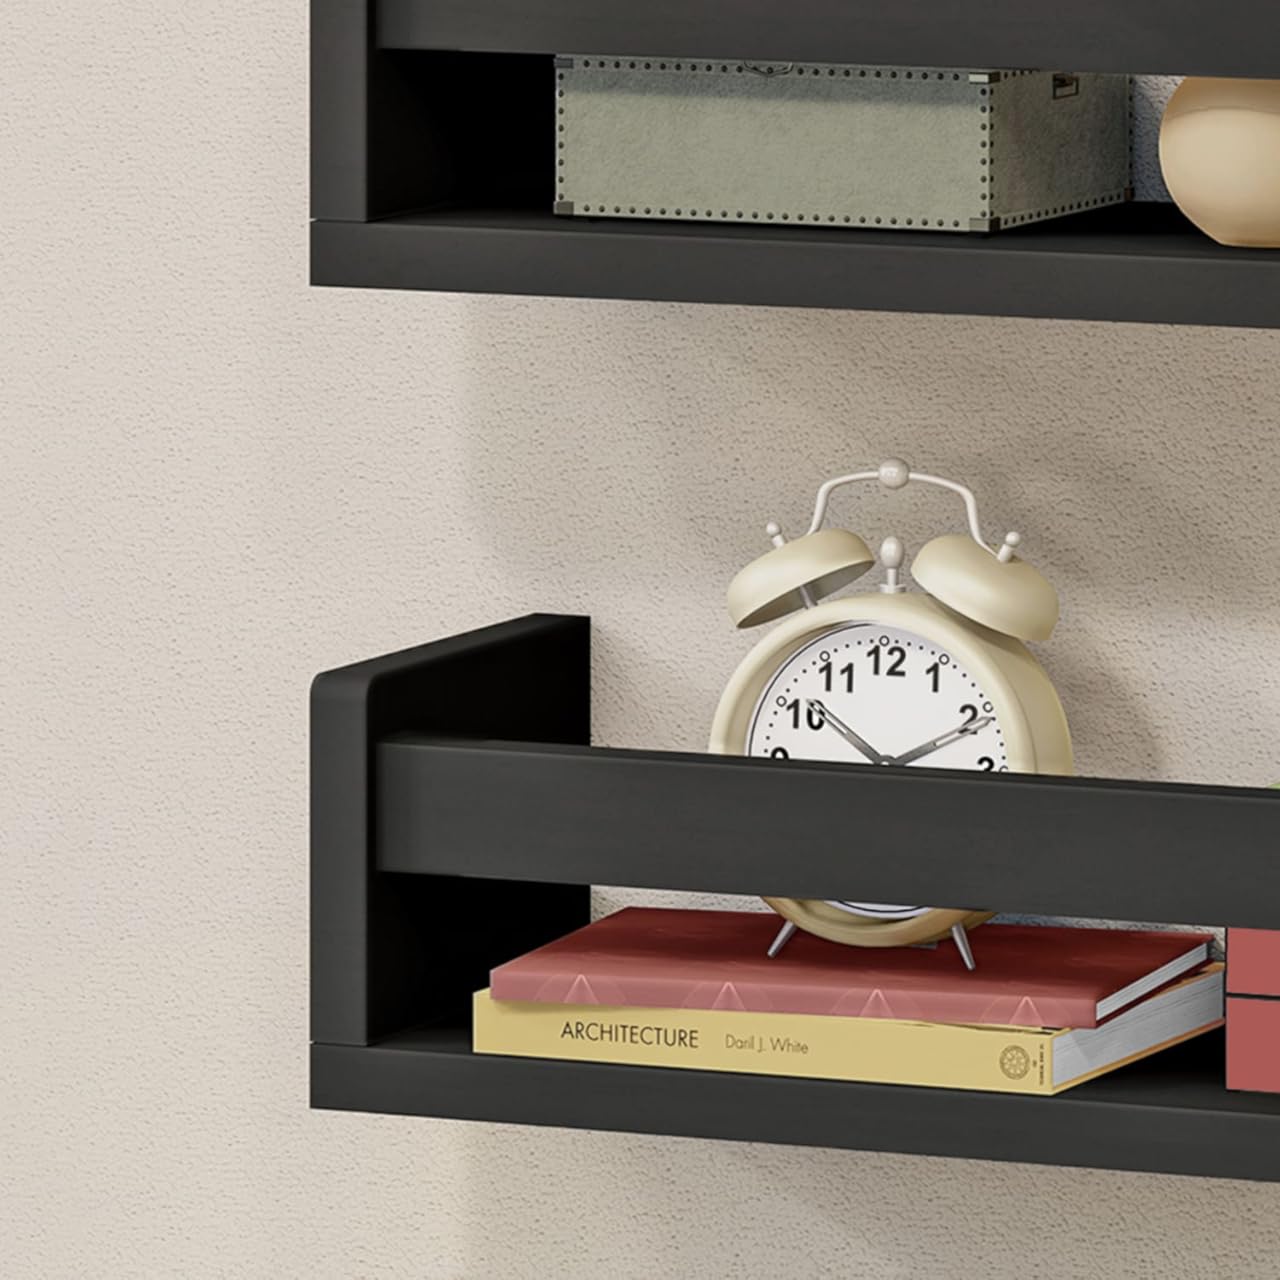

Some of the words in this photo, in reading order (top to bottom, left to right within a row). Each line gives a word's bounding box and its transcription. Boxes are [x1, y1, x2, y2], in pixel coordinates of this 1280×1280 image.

[818, 661, 855, 693] 11
[865, 644, 908, 678] 12
[924, 661, 941, 693] 1
[785, 698, 826, 731] 10
[957, 703, 980, 736] 2
[560, 1021, 699, 1049] ARCHITECTURE
[769, 1037, 809, 1055] White
